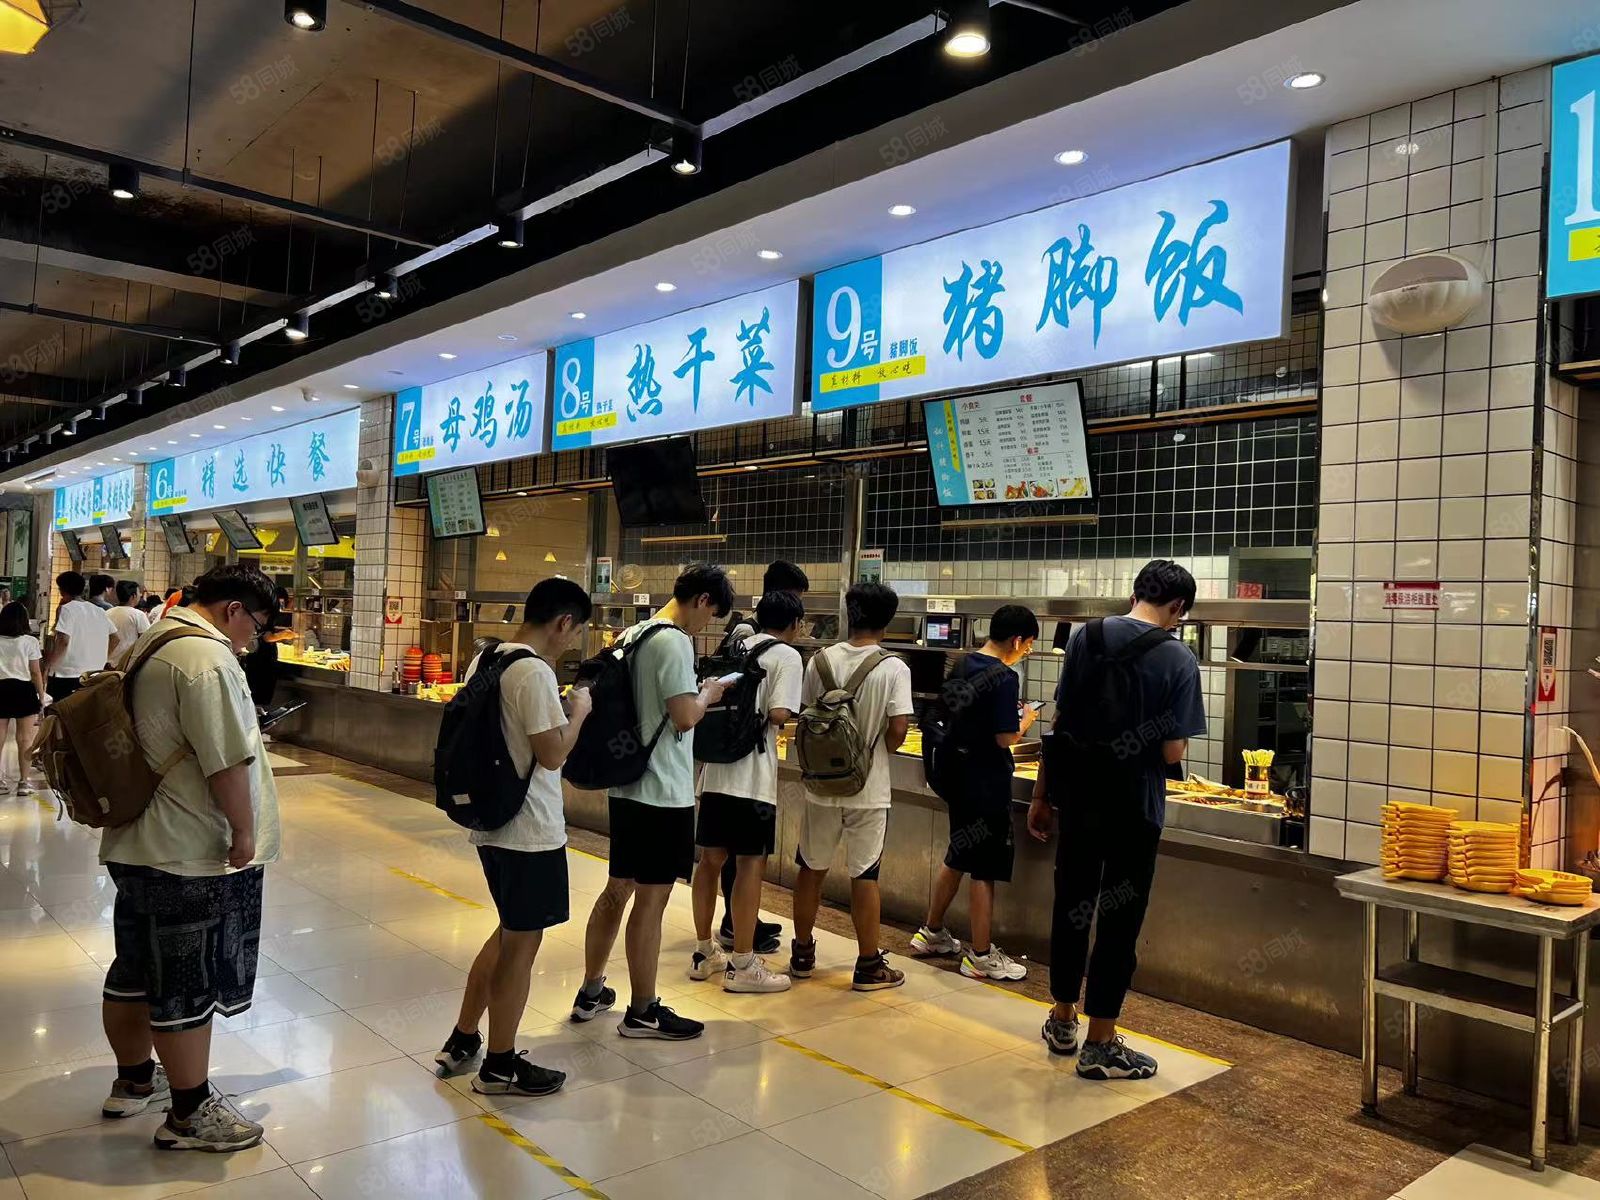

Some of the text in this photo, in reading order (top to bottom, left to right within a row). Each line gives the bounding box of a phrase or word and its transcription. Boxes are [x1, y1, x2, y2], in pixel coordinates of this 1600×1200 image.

[942, 199, 1244, 361] 猪脚饭
[626, 306, 775, 422] 热干菜
[826, 286, 878, 368] 9号
[440, 379, 533, 453] 母鸡汤
[560, 357, 592, 418] 8号
[401, 401, 421, 450] 7号
[202, 431, 331, 499] 精选快餐
